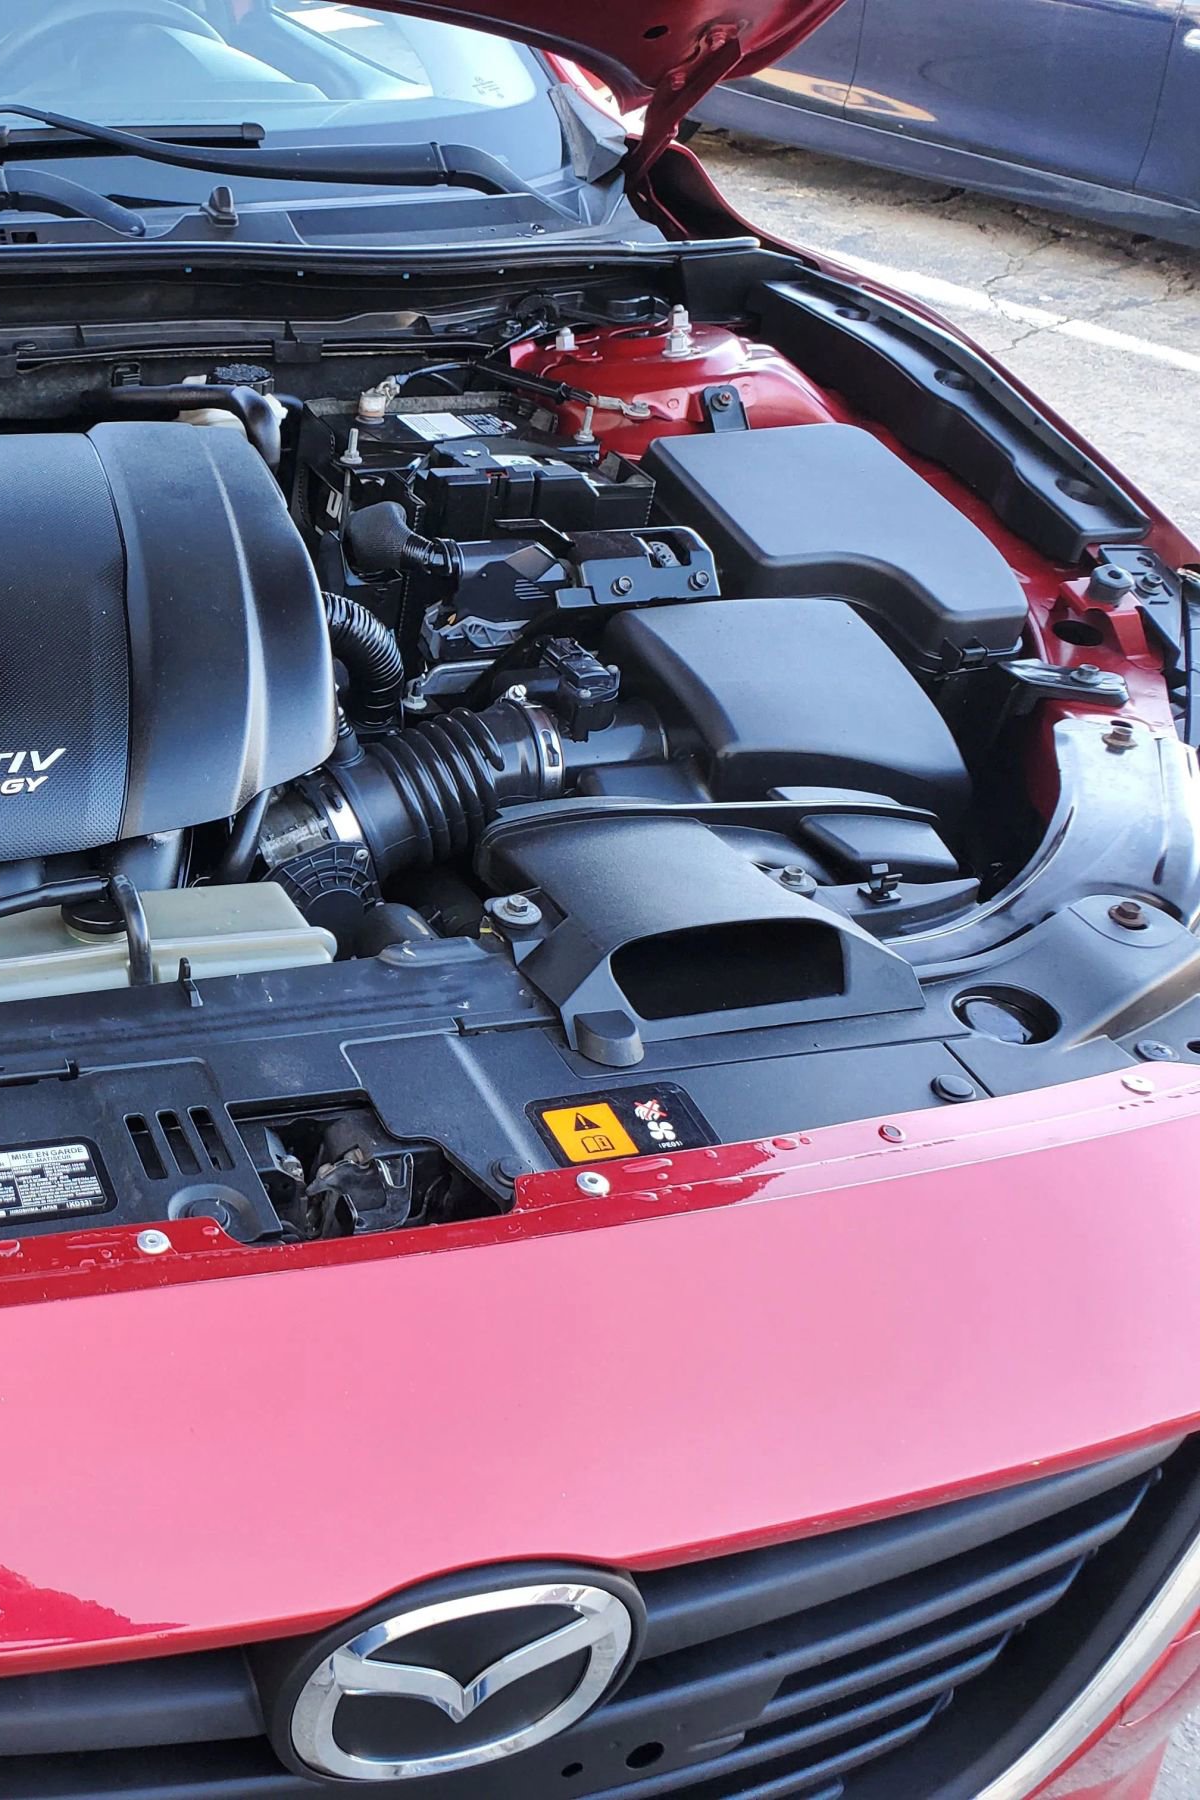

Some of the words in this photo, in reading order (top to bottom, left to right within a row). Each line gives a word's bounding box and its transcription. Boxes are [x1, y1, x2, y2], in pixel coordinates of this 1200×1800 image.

[11, 1152, 36, 1161] MISE
[37, 1150, 51, 1158] EN
[52, 1146, 84, 1156] GARDE
[25, 1154, 73, 1164] CLIMATISEUR
